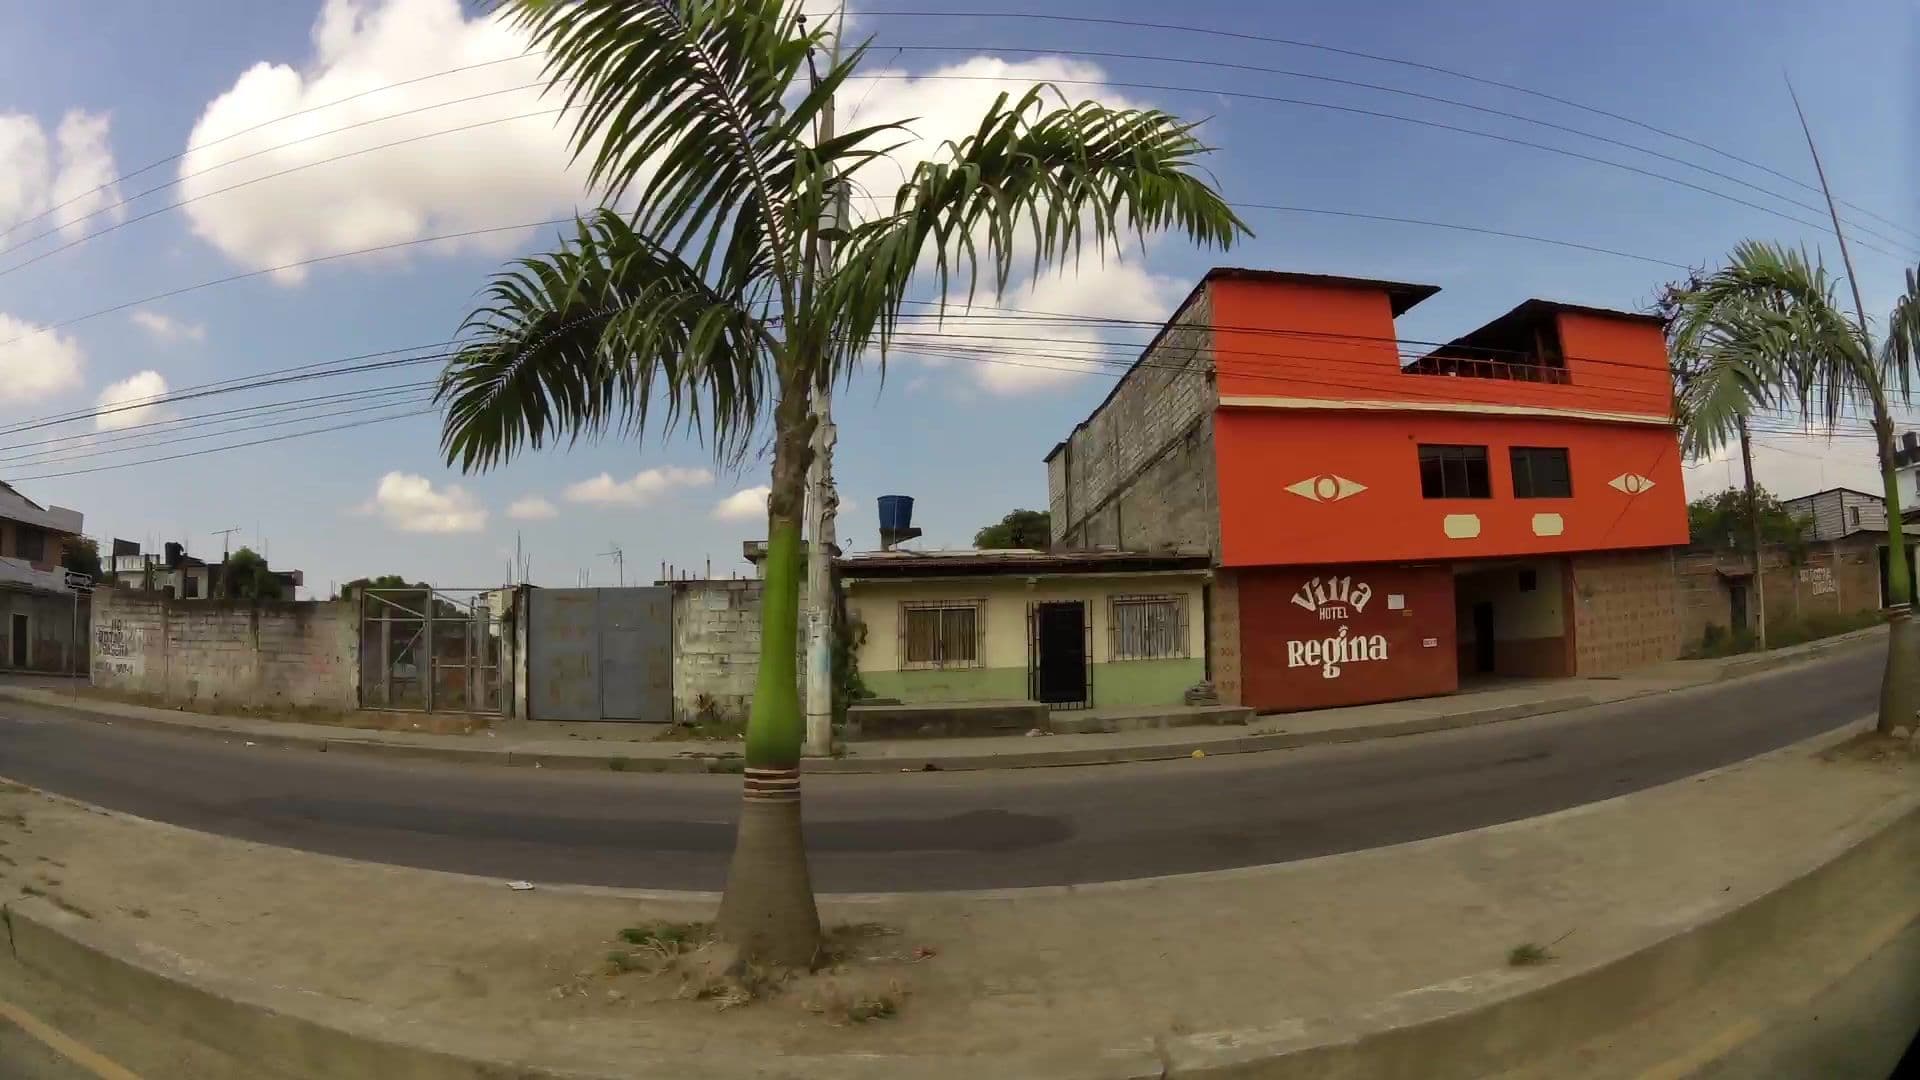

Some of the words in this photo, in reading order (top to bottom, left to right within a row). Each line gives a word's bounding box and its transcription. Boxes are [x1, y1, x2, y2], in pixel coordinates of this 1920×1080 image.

[1291, 576, 1372, 613] Villa
[1319, 607, 1349, 620] HOTEL
[1287, 626, 1388, 679] Regina
